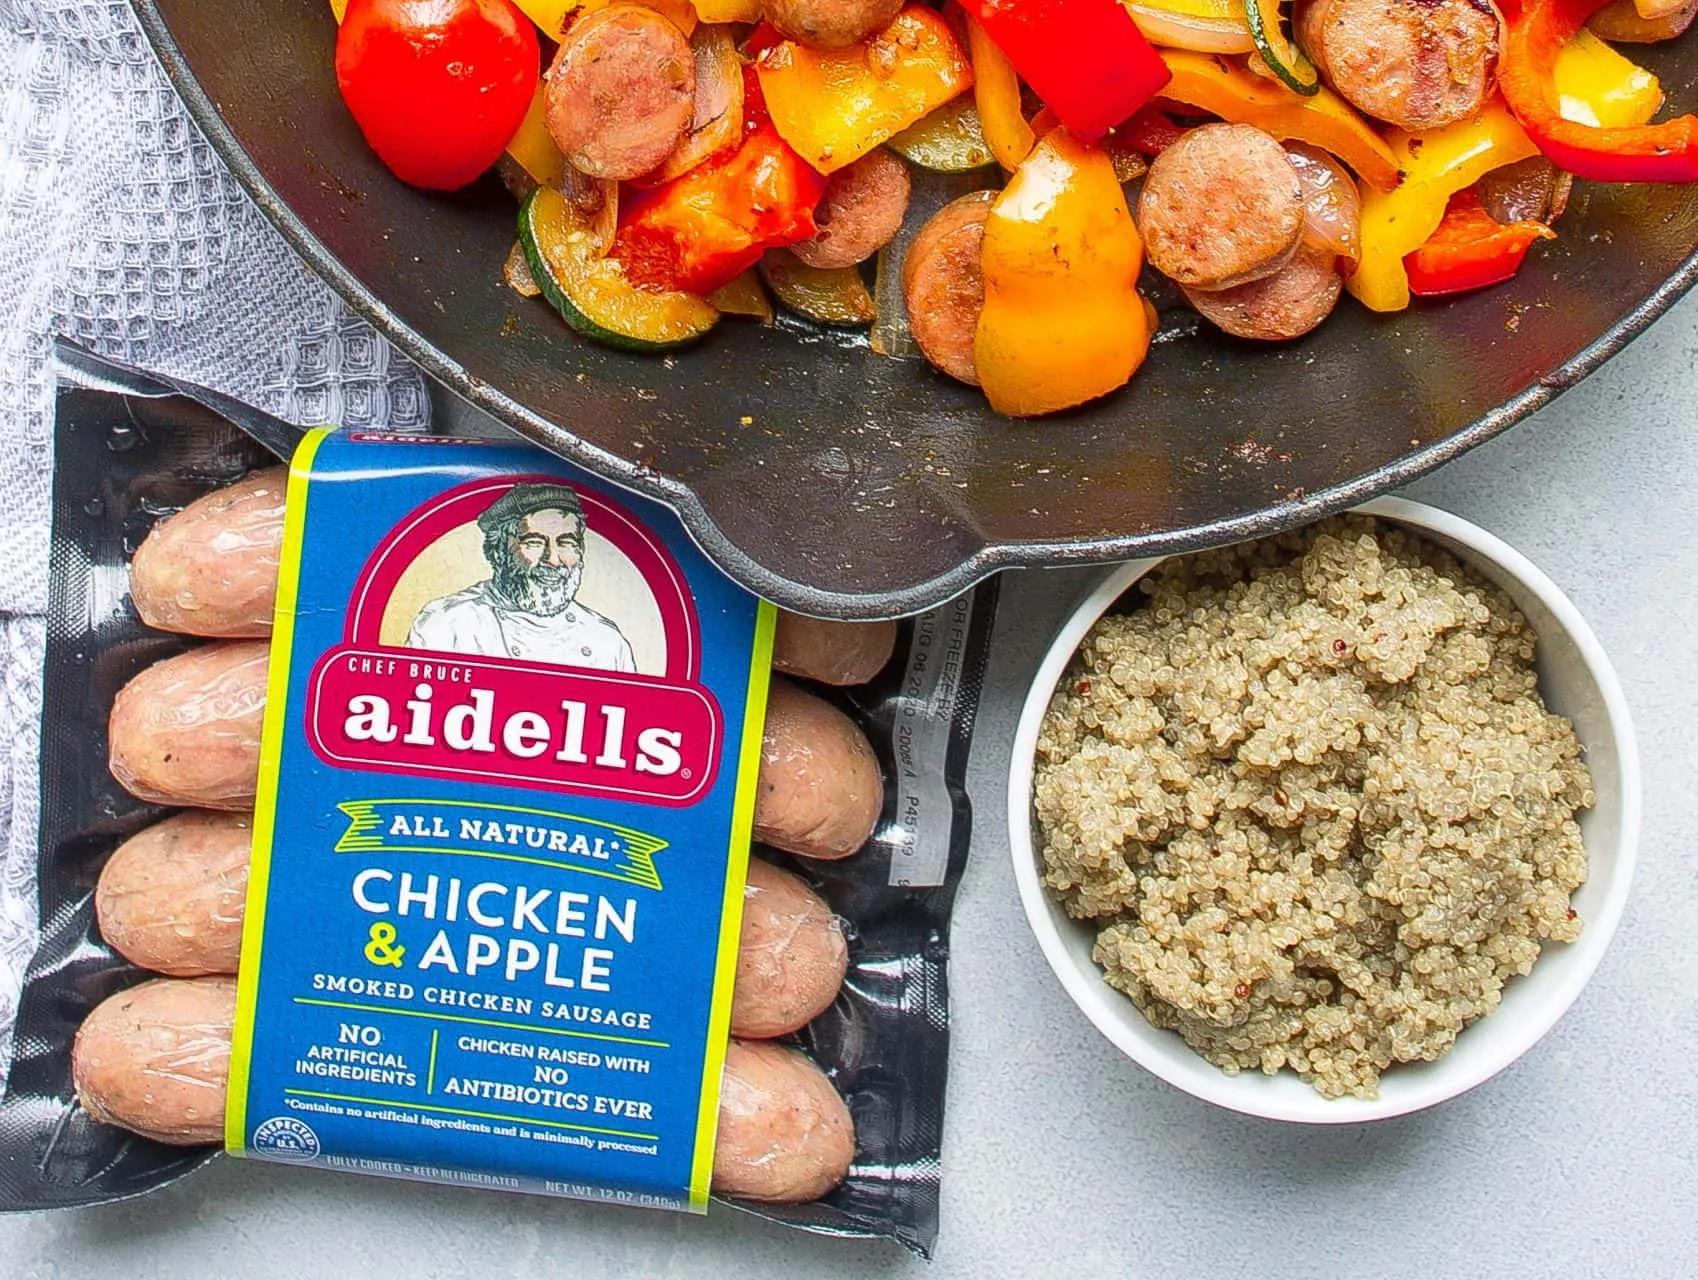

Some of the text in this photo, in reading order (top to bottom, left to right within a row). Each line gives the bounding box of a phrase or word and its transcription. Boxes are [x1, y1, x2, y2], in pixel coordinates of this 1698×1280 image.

[348, 657, 473, 683] CHEF BRUCE
[390, 815, 450, 839] ALL
[352, 868, 637, 943] CHICKEN
[364, 921, 614, 992] & APPLE
[313, 974, 652, 1030] SMOKED CHICKEN SAUSAGE
[338, 1023, 381, 1047] NO
[307, 1045, 408, 1069] ARTIFICIAL
[458, 1036, 650, 1074] CHICKEN RAISED WITH
[295, 1060, 417, 1087] INGREDIENTS
[533, 1065, 569, 1086] NO
[444, 1077, 653, 1120] ANTIBIOTICS EVER
[258, 1119, 316, 1146] INSPECTED
[346, 1108, 362, 1118] no
[364, 1110, 418, 1125] artificial
[421, 1116, 491, 1134] ingredients
[493, 1125, 517, 1138] and
[519, 1127, 531, 1139] is
[533, 1131, 596, 1150] minimally
[597, 1139, 658, 1156] processed
[326, 1155, 358, 1169] FULLY
[360, 1158, 402, 1173] COOKED
[545, 1180, 569, 1194] NET
